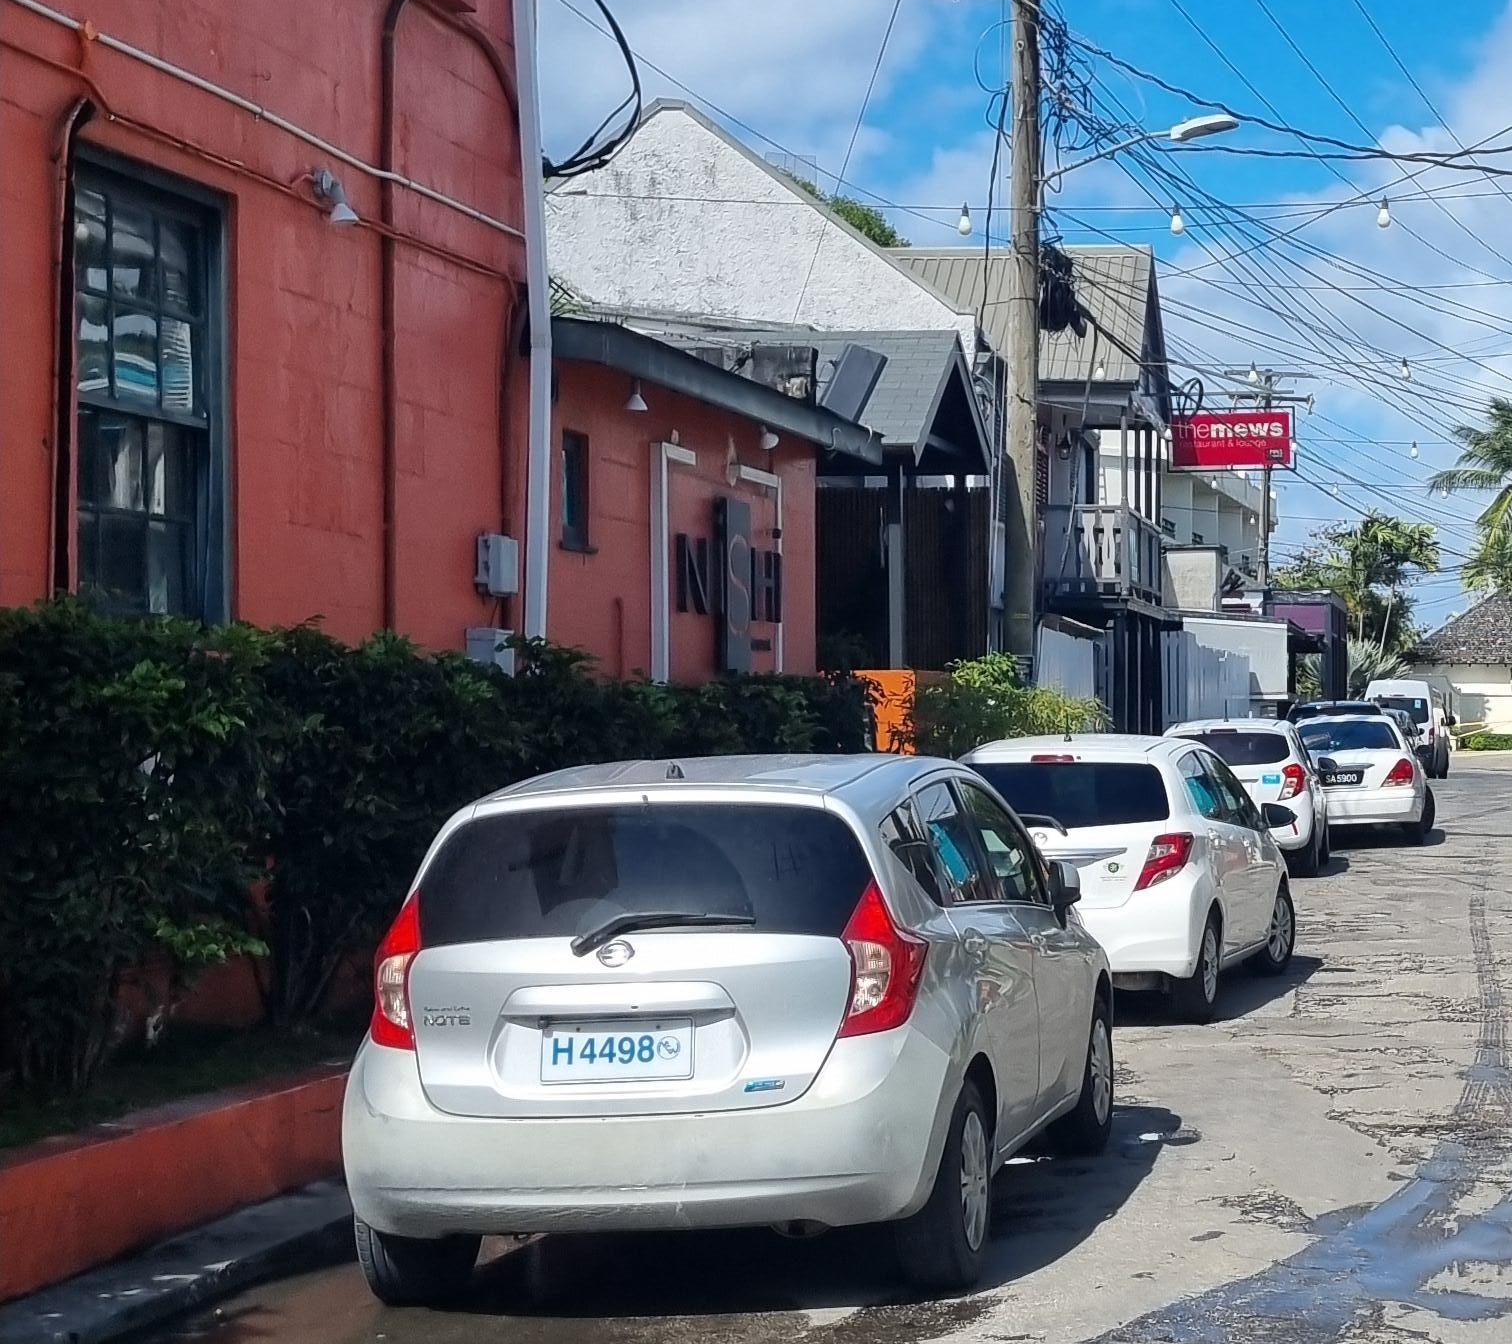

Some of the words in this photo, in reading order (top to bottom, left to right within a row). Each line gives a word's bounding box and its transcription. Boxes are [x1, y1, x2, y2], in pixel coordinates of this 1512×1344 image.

[423, 1015, 471, 1027] NOTE
[551, 1037, 573, 1066] H
[579, 1034, 655, 1065] 4498
